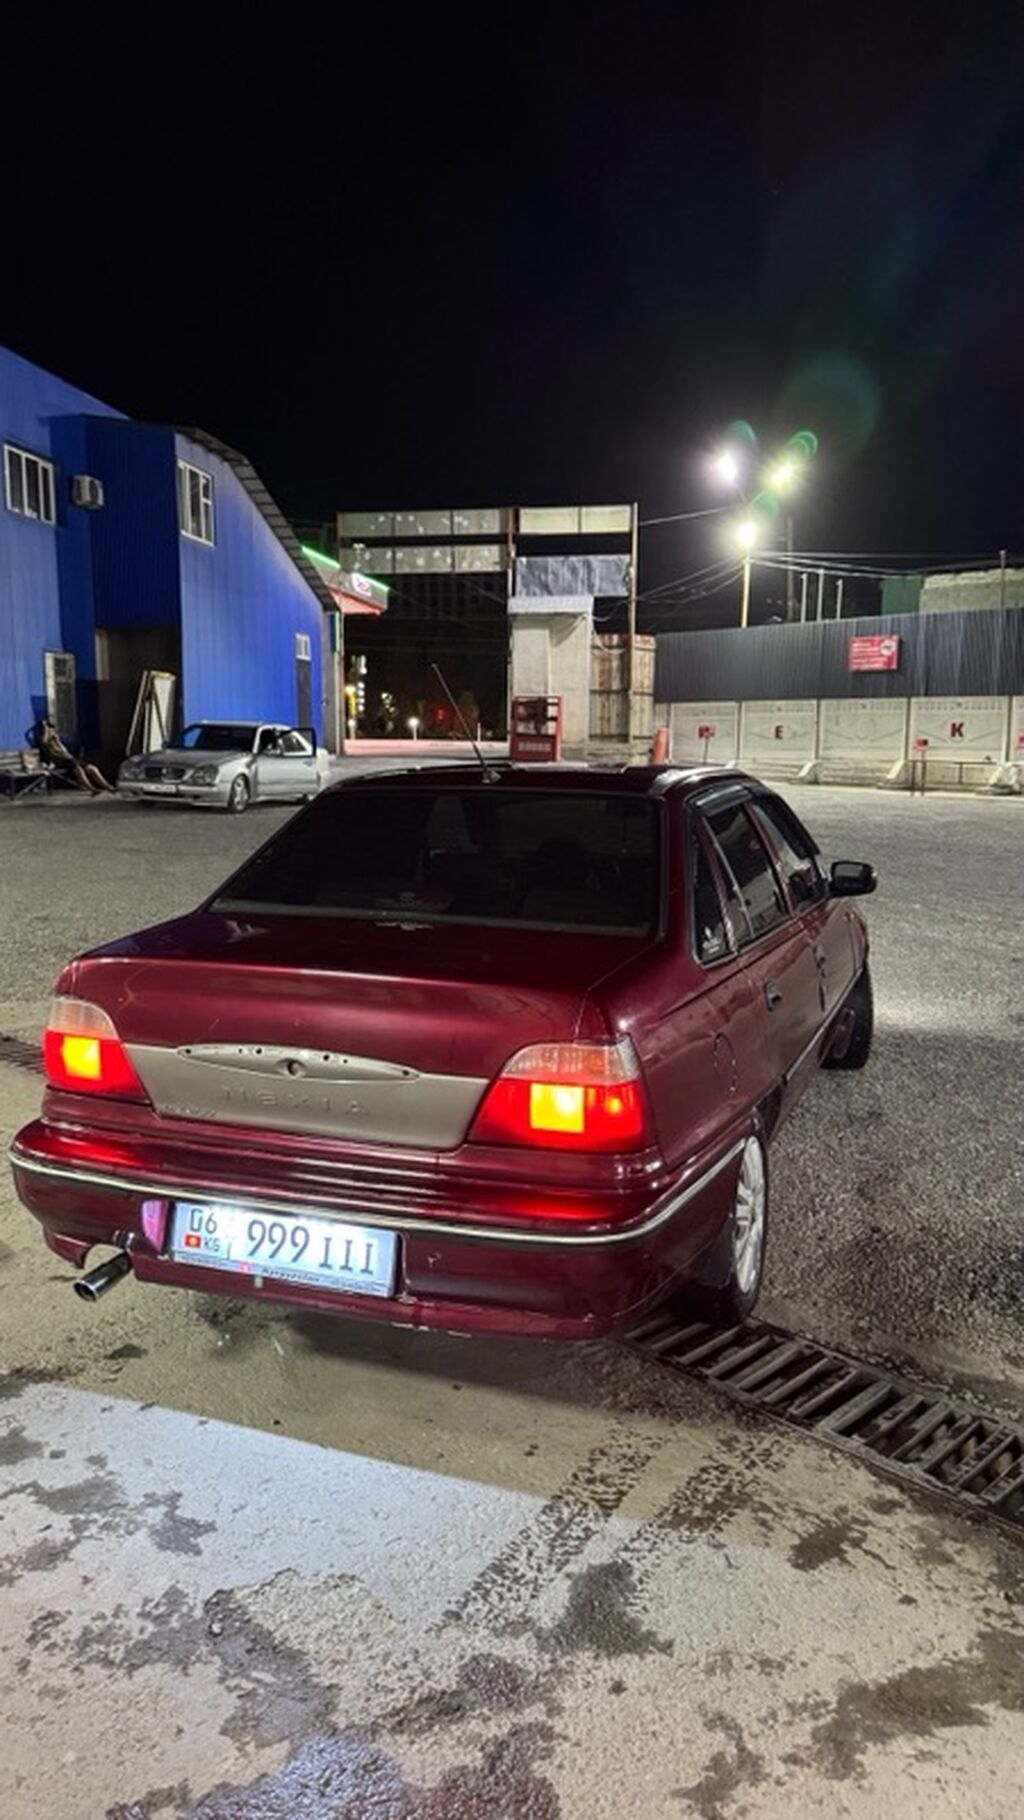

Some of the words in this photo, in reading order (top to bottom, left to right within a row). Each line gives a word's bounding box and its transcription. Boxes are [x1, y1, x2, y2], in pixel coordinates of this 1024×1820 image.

[189, 1207, 219, 1235] 06
[247, 1218, 310, 1263] 999
[318, 1236, 374, 1276] III
